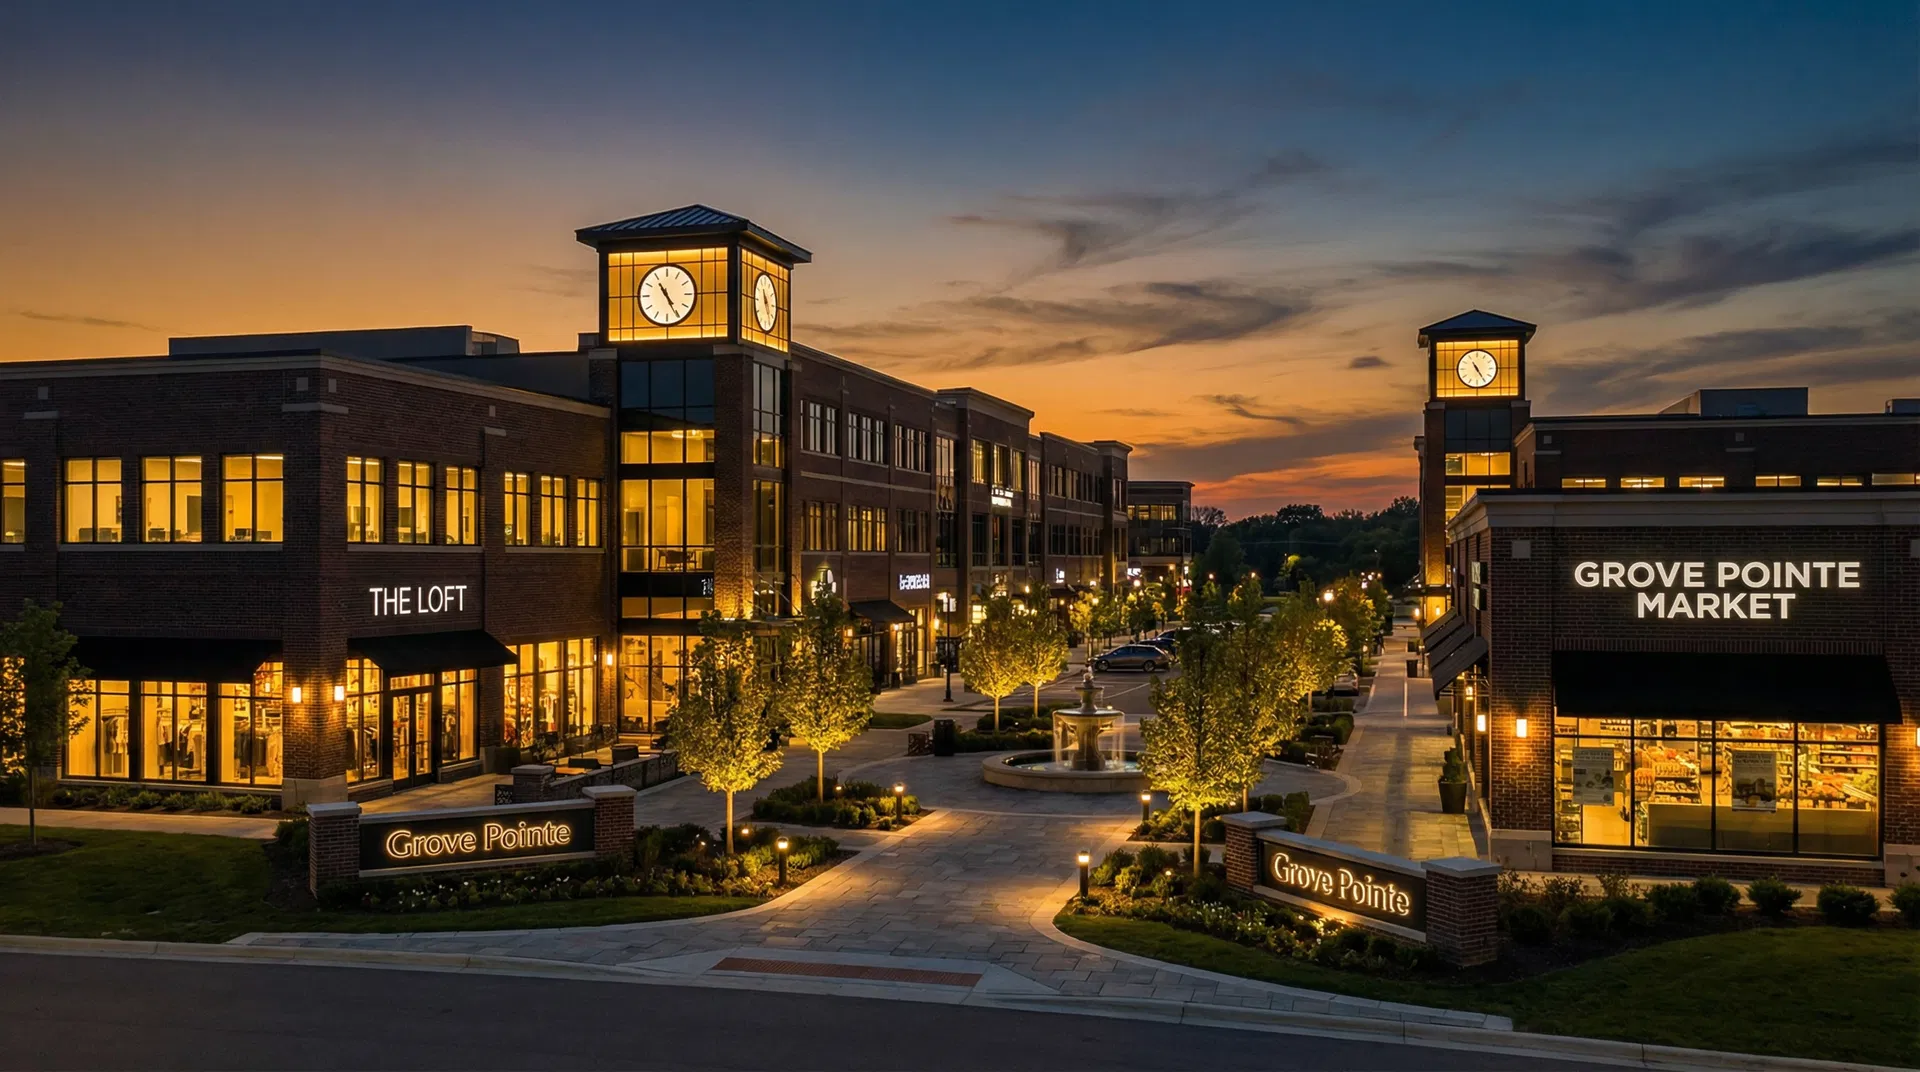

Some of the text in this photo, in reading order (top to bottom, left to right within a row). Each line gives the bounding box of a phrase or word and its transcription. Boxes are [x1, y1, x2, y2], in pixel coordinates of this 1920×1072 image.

[1574, 561, 1861, 589] GROVE POINTE
[369, 585, 467, 616] THE LOFT
[1637, 592, 1796, 619] MARKET
[386, 820, 572, 859] Grove Pointe
[1273, 852, 1411, 917] Grove Pointe
